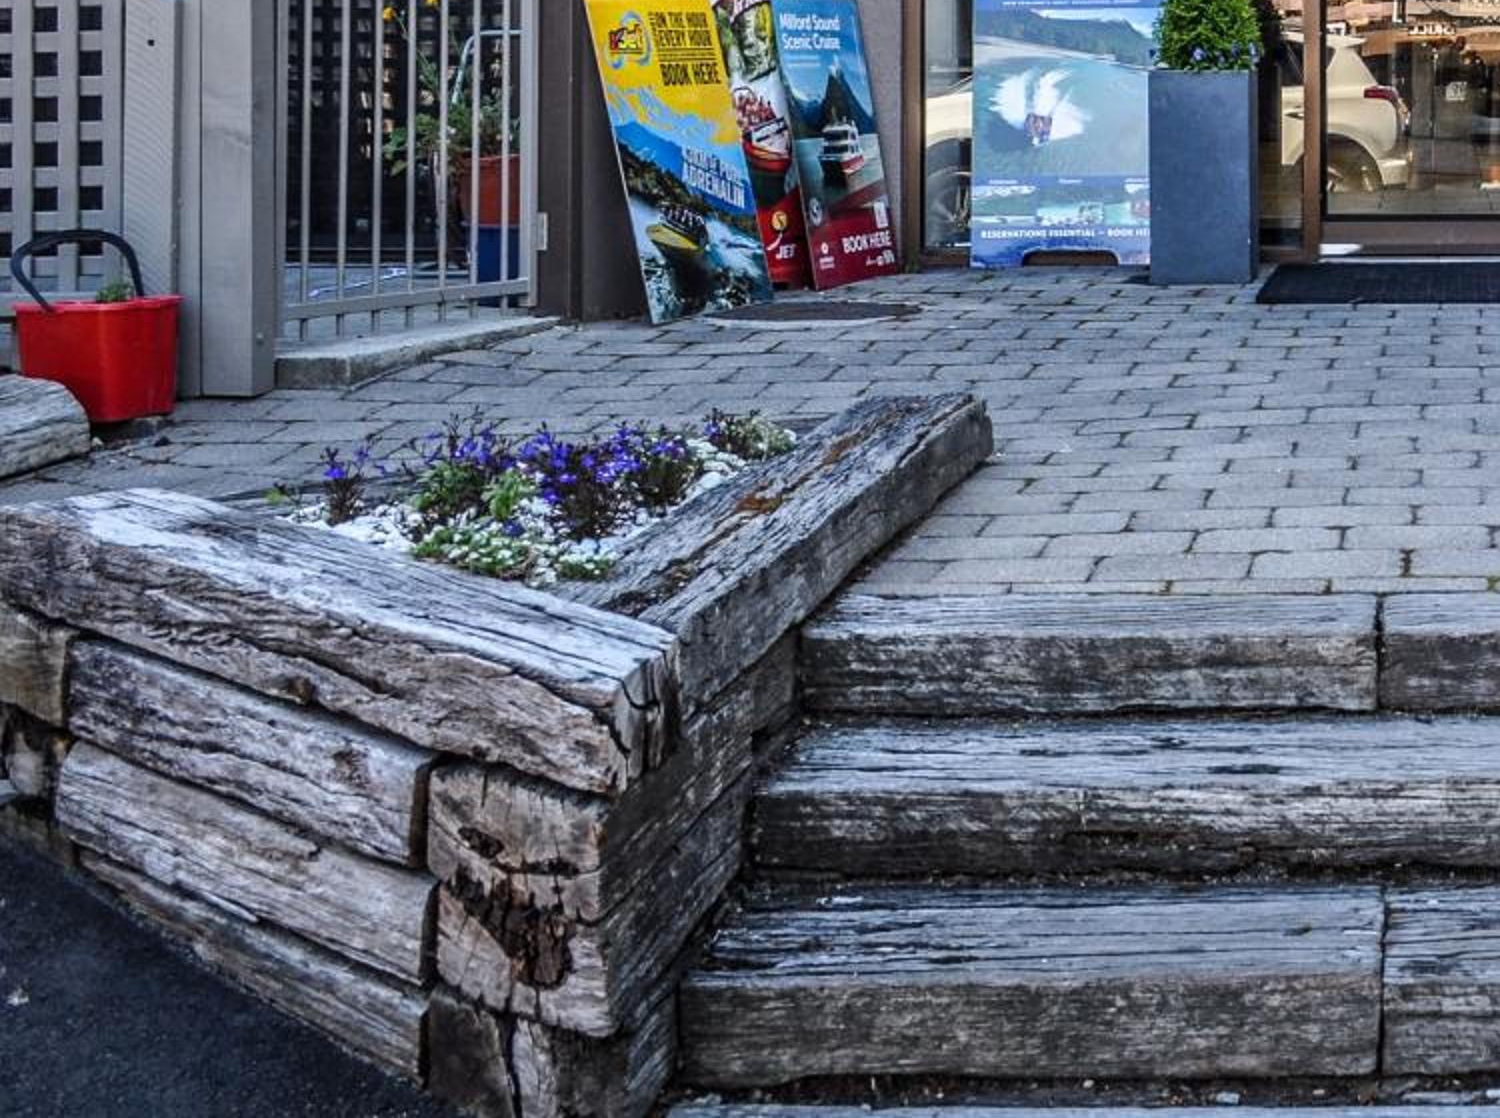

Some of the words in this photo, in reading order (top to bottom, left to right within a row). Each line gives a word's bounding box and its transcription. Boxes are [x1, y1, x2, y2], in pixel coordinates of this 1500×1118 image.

[668, 11, 686, 28] THE
[779, 12, 812, 31] Milford
[812, 13, 841, 31] Sound
[782, 33, 813, 50] Scenic
[813, 32, 841, 50] Cruise
[660, 63, 693, 86] BOOK
[691, 63, 721, 84] HERE
[842, 235, 870, 254] BOOK
[869, 229, 893, 249] HERE
[981, 229, 1047, 239] RESERVATIONS
[1049, 229, 1095, 238] ESSENTIAL
[1107, 228, 1134, 238] BOOK
